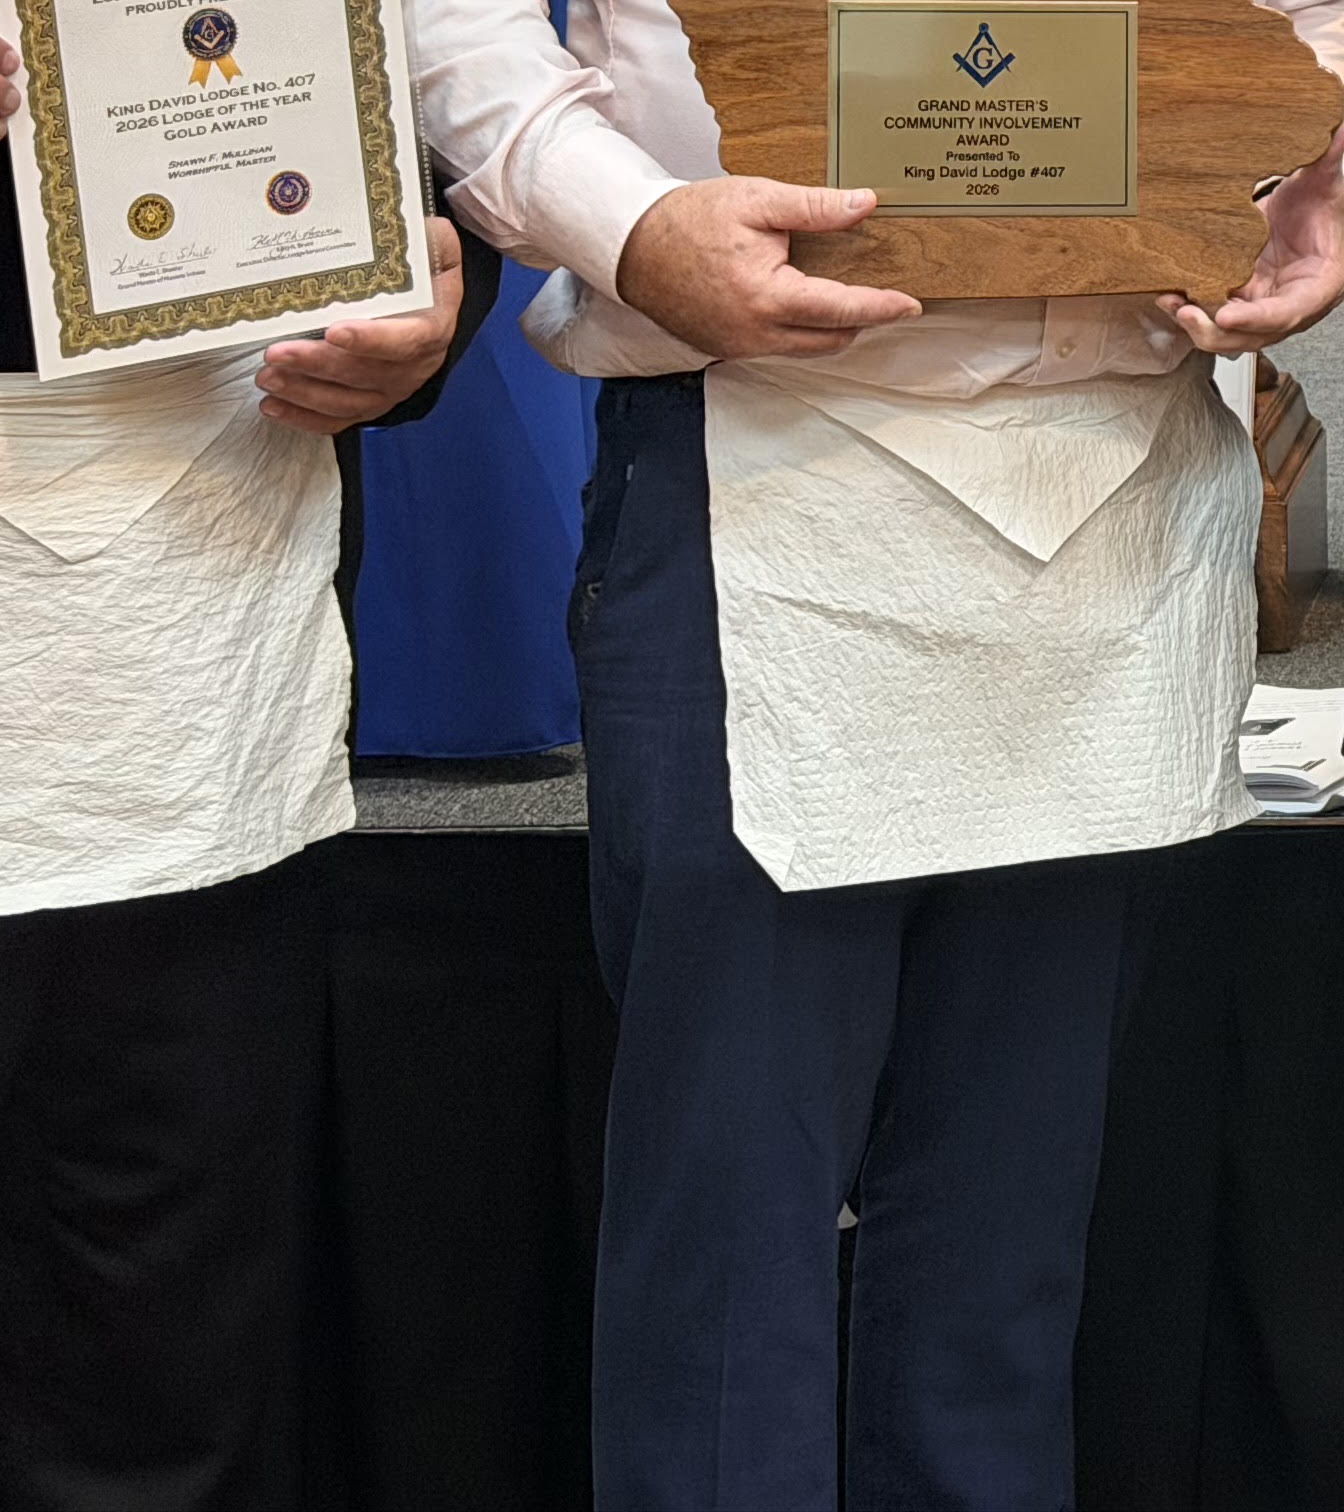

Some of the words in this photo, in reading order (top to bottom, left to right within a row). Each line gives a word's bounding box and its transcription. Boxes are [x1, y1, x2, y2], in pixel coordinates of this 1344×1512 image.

[972, 48, 994, 70] G
[199, 85, 250, 103] LODGE
[284, 73, 316, 88] 407
[115, 116, 160, 133] 2026
[162, 107, 215, 125] LODGE
[217, 104, 238, 115] OF
[240, 98, 270, 112] THE
[273, 92, 312, 106] YEAR
[918, 99, 971, 112] GRAND
[975, 99, 1049, 112] MASTER'S
[164, 125, 207, 141] GOLD
[210, 115, 268, 134] AWARD
[884, 117, 975, 130] COMMUNITY
[979, 117, 1082, 130] INVOLVEMENT
[956, 134, 1010, 147] AWARD
[946, 151, 1004, 162] Presented
[1007, 151, 1020, 162] To
[904, 166, 936, 181] King
[939, 166, 978, 178] David
[982, 166, 1025, 181] Lodge
[1031, 167, 1066, 179] #407
[965, 184, 1000, 196] 2026
